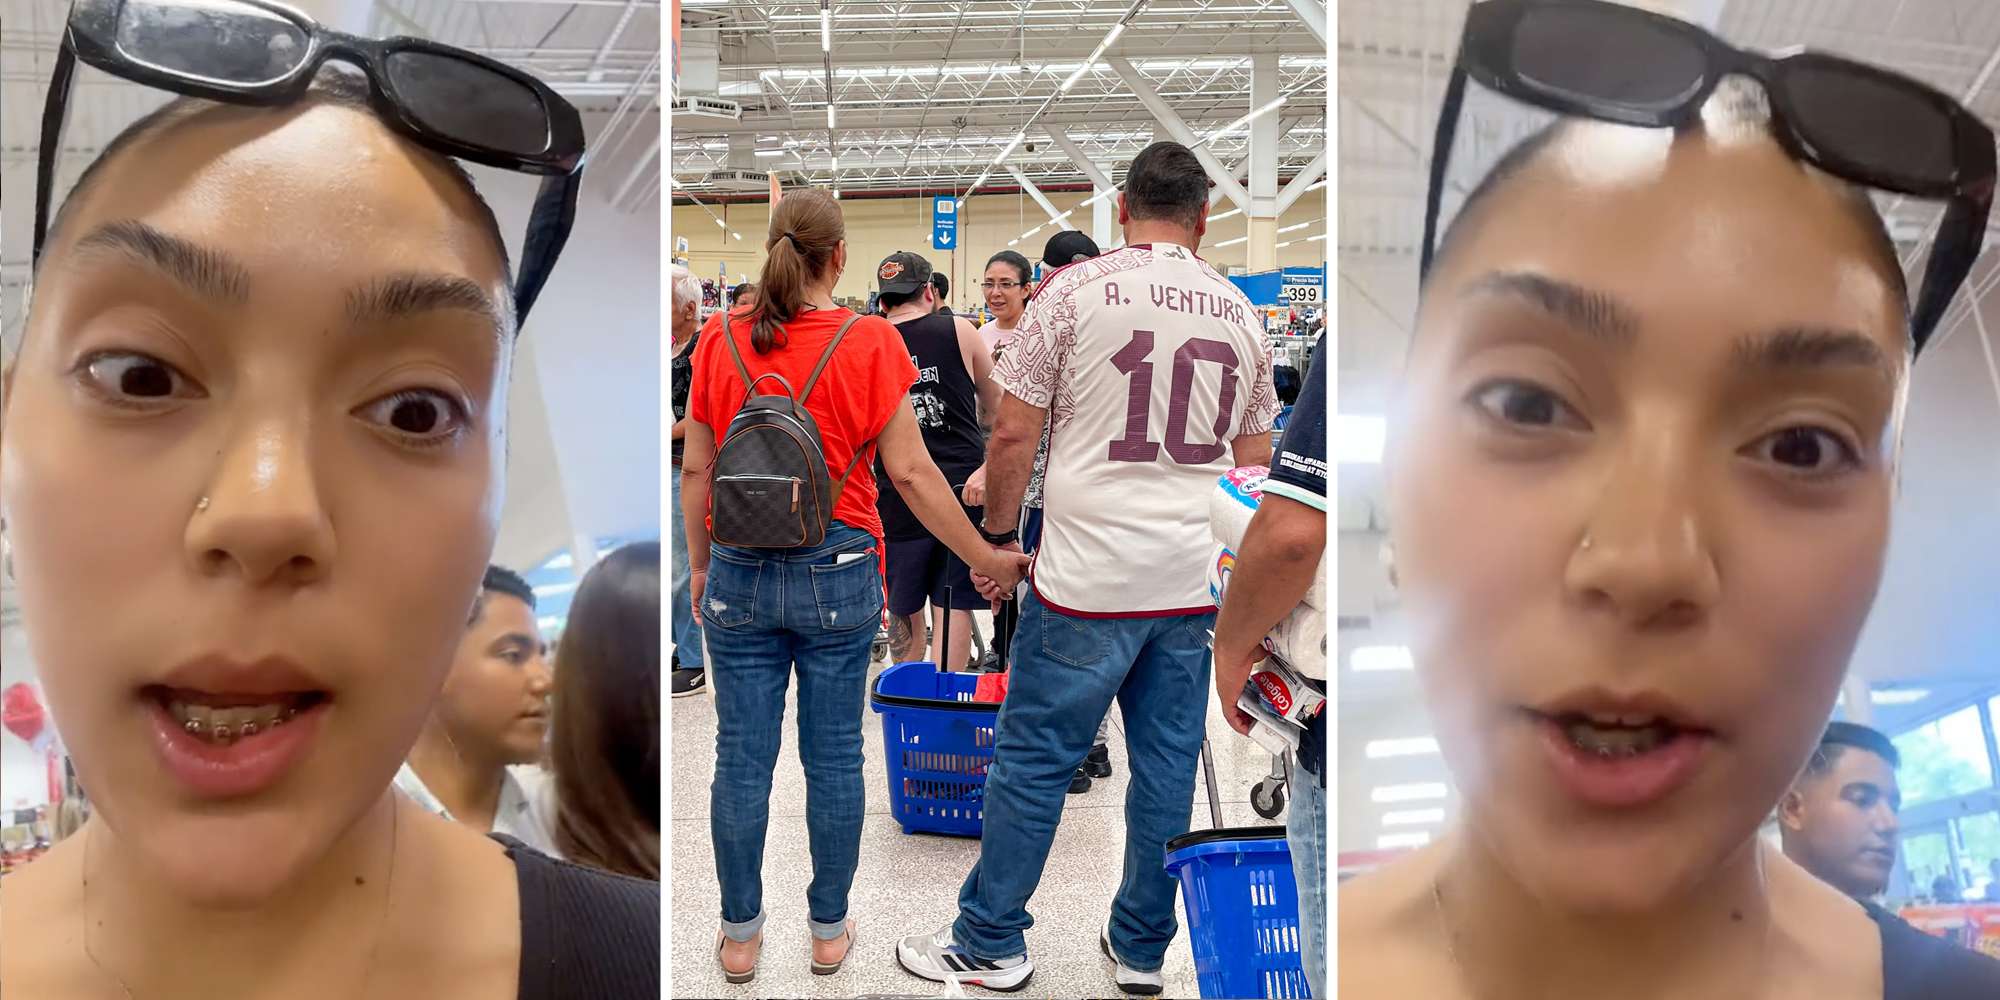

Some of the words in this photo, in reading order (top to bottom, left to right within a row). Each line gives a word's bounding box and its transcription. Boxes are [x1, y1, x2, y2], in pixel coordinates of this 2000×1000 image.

[1289, 287, 1317, 302] 399
[1308, 277, 1319, 285] bajo
[1104, 281, 1131, 306] A.
[1149, 283, 1247, 327] VENTURA
[1108, 329, 1240, 465] 10
[1259, 674, 1290, 711] Colgate
